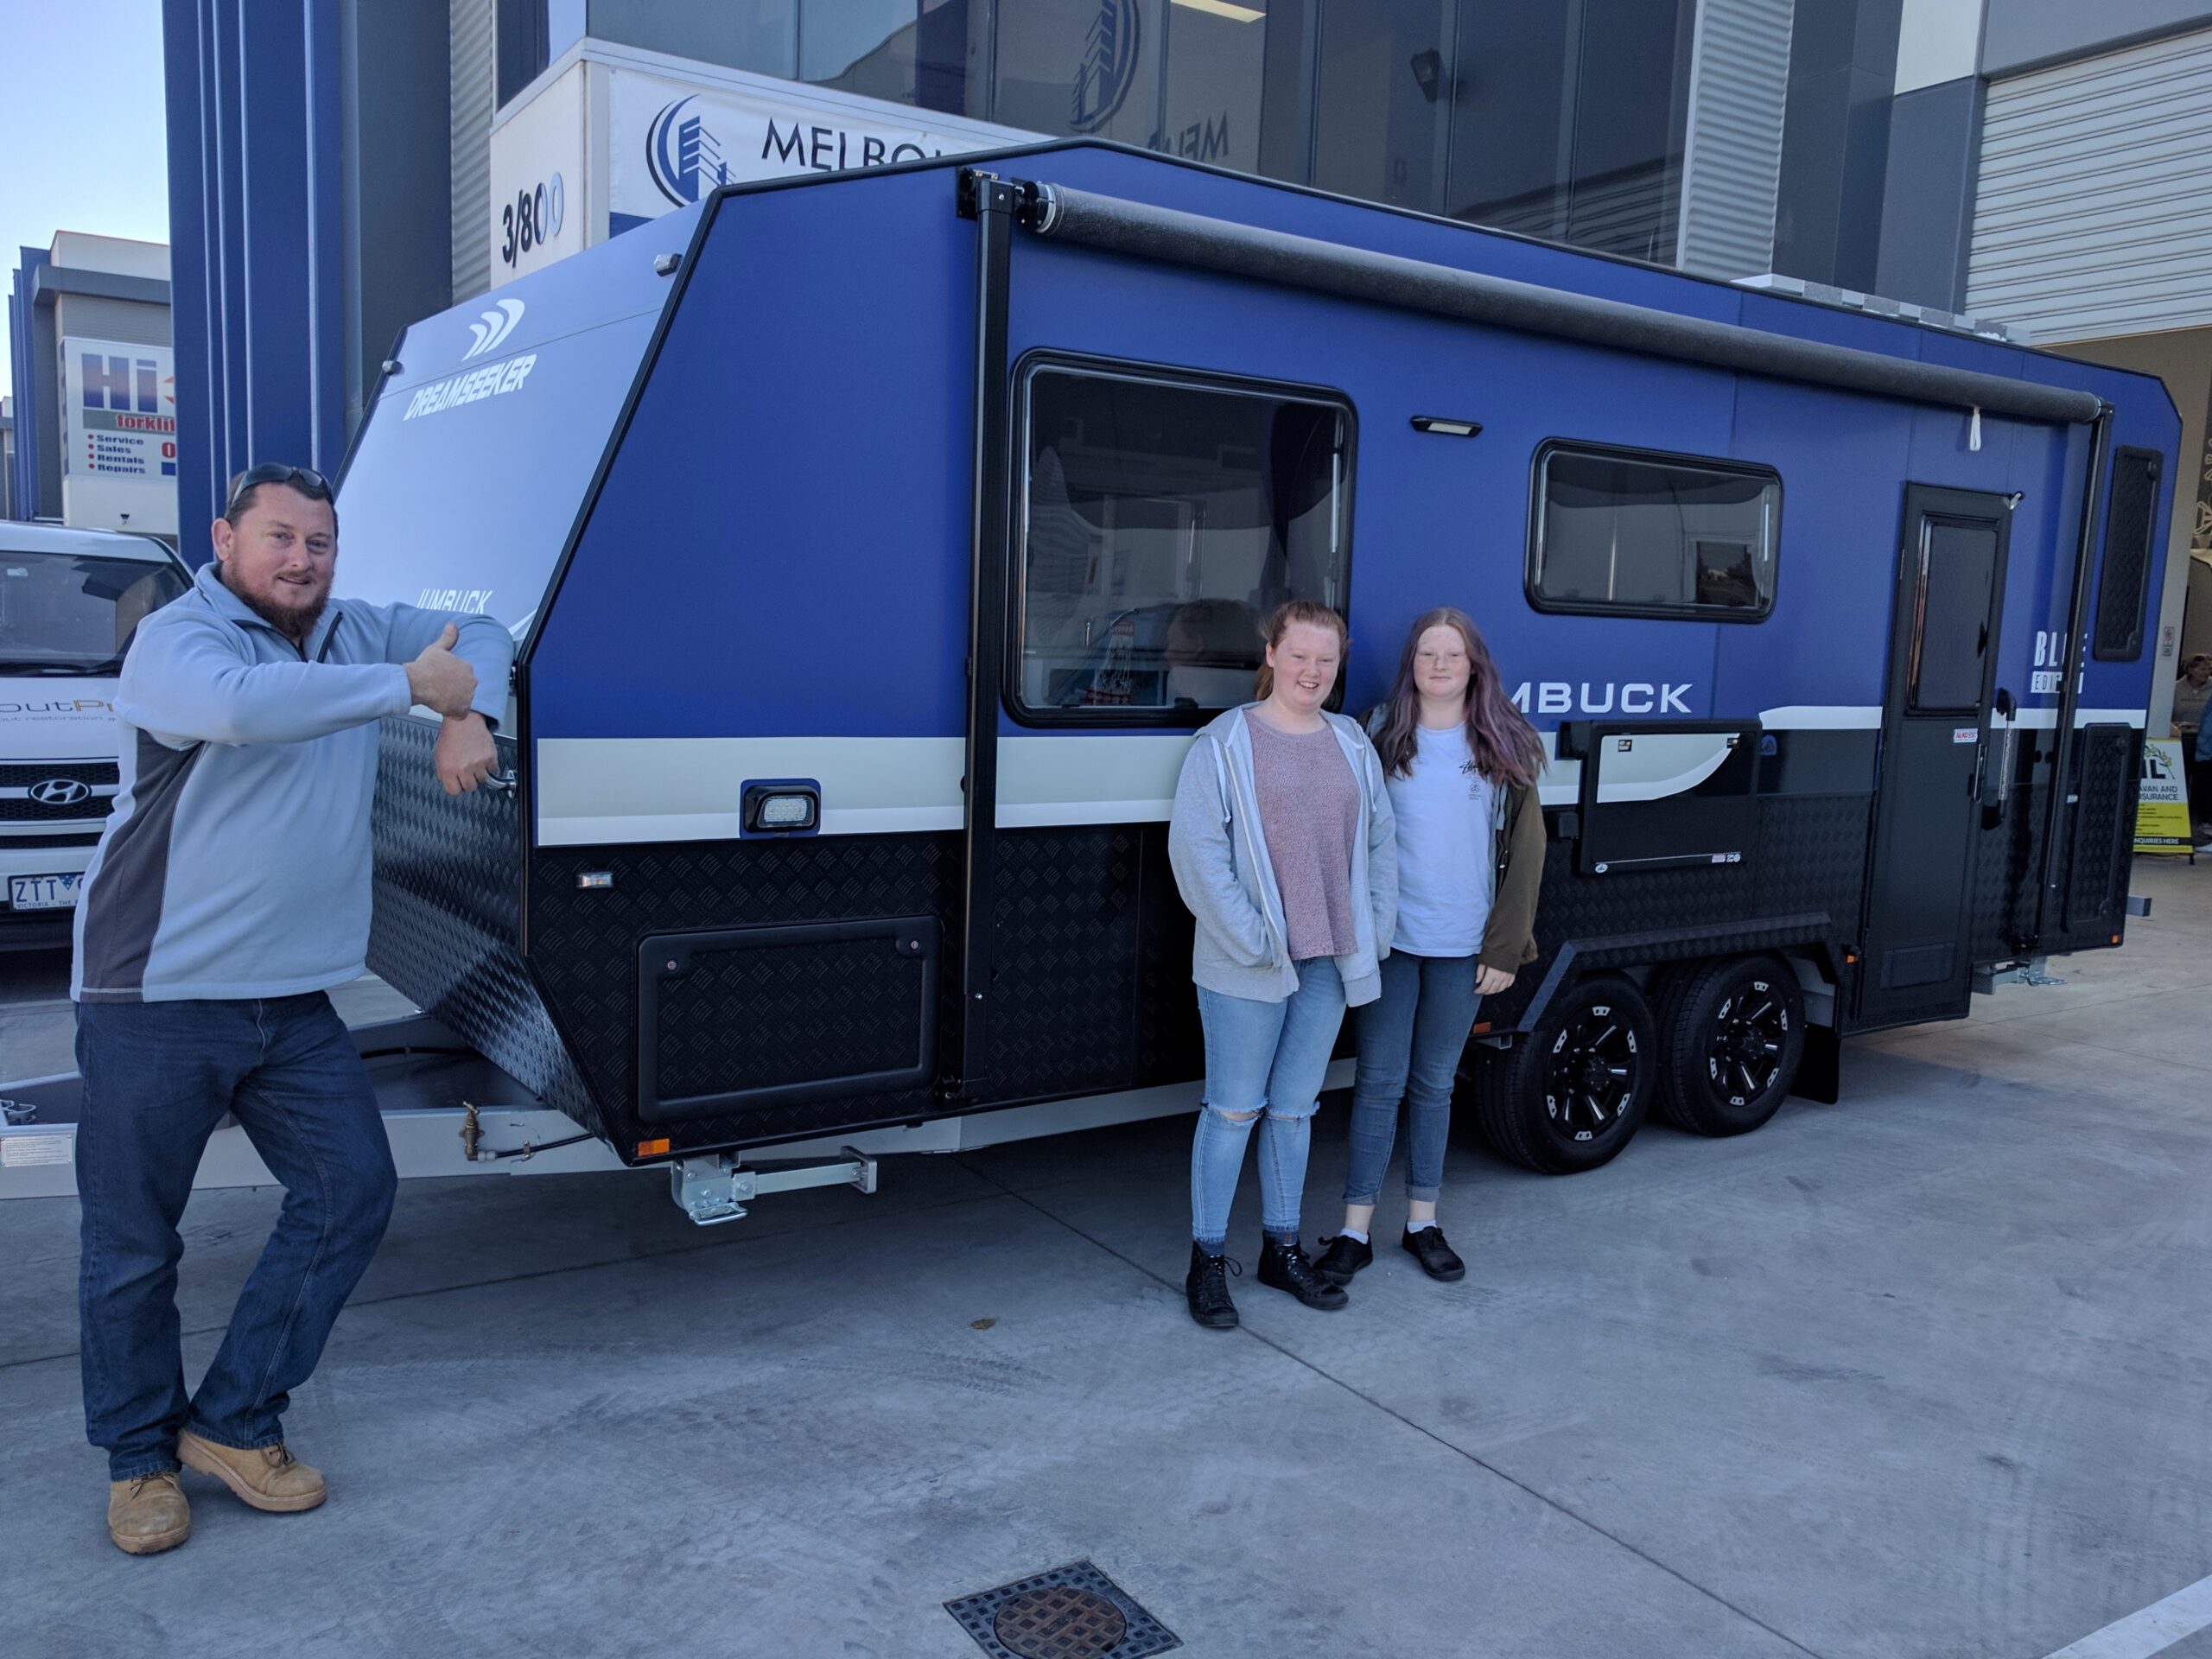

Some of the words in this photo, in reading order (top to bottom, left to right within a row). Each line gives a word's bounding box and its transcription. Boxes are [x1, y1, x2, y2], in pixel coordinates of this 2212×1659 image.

[761, 118, 942, 171] MELBO
[502, 172, 563, 268] 3/800
[403, 353, 537, 422] DREAMSEEKER
[97, 435, 143, 445] Service
[97, 444, 131, 454] Sales
[97, 454, 144, 465] Rentals
[98, 463, 145, 474] Repairs
[1511, 682, 1693, 714] MBUCK
